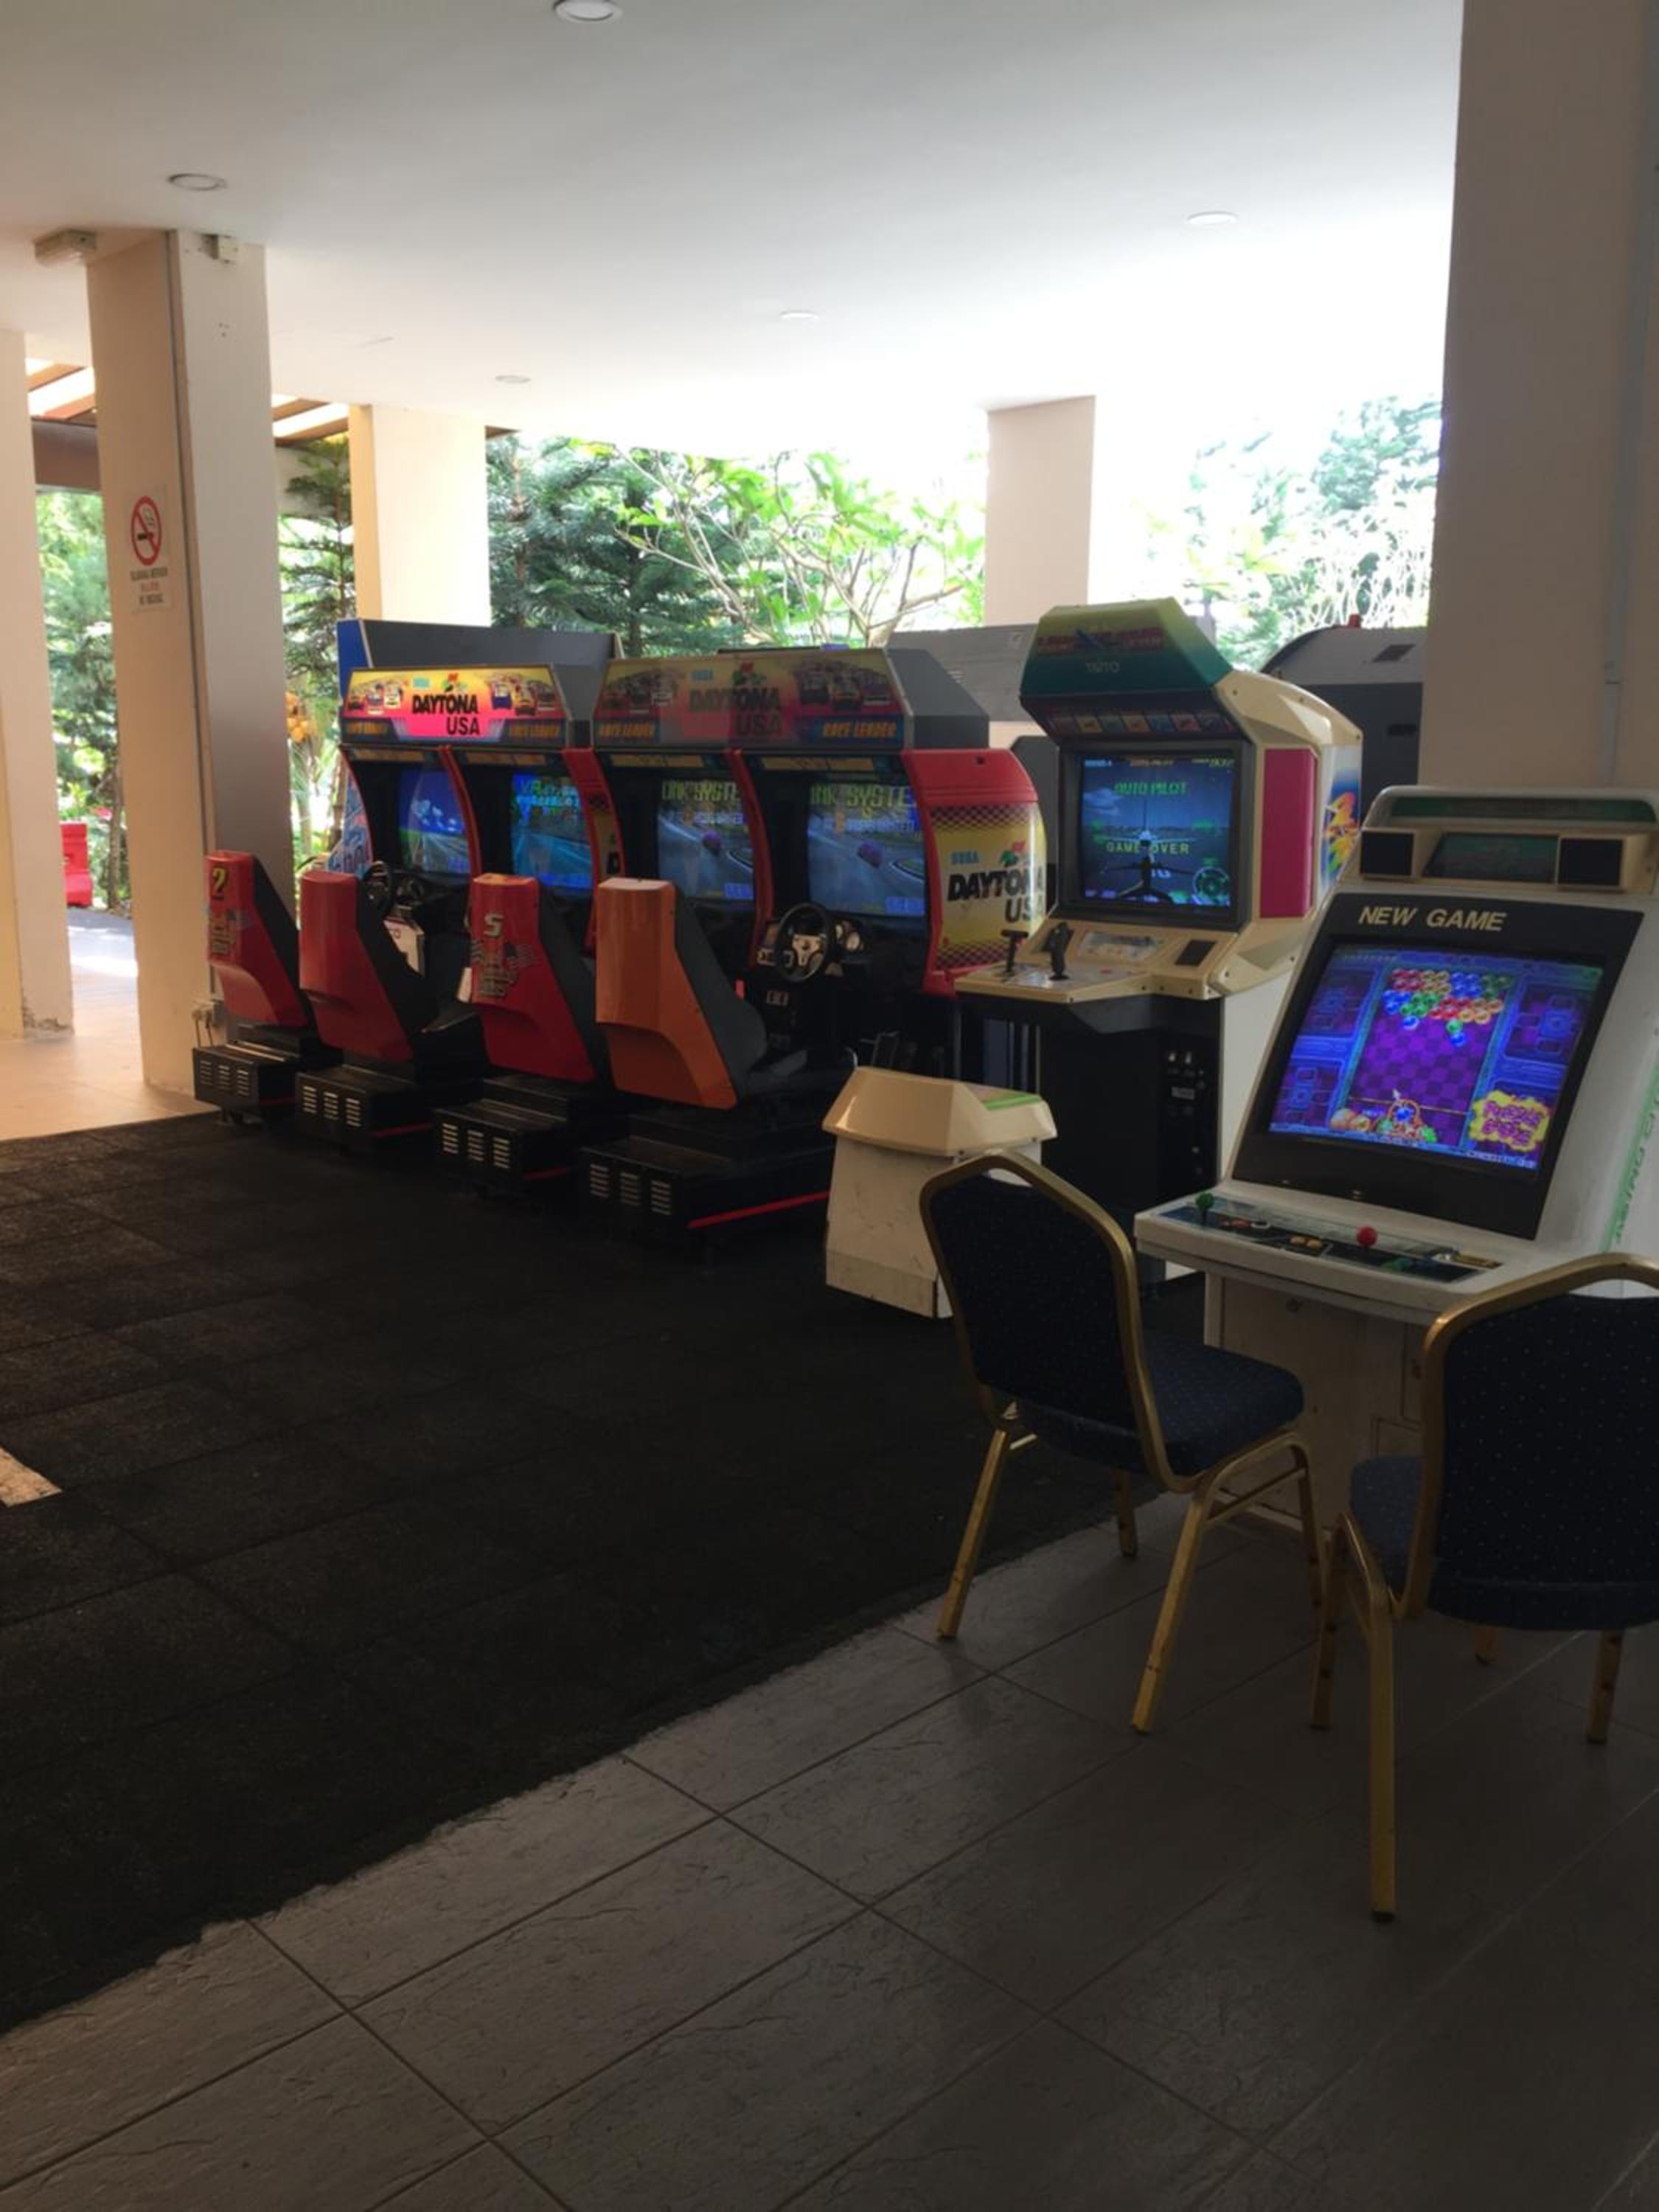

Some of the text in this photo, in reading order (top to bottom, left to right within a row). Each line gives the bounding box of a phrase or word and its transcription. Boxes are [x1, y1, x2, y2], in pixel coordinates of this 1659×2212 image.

[412, 694, 479, 714] DAYTONA
[689, 687, 782, 712] DAYTONA
[446, 717, 480, 735] USA
[737, 714, 782, 736] USA
[847, 784, 917, 808] SYSTE
[1106, 841, 1190, 855] GAME OVER
[1357, 905, 1508, 933] NEW GAME
